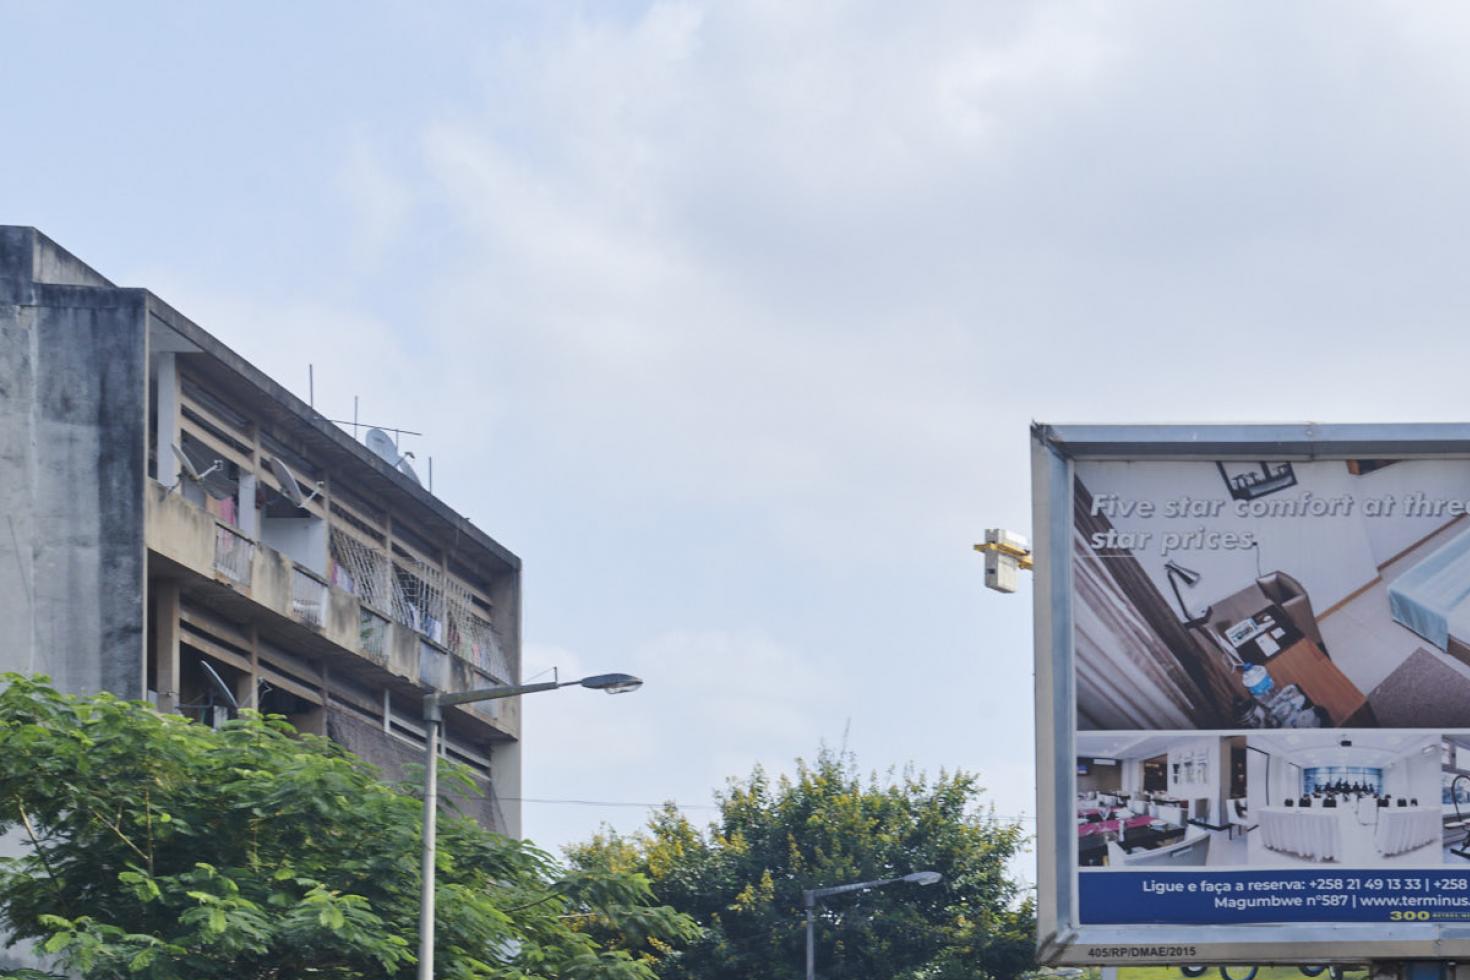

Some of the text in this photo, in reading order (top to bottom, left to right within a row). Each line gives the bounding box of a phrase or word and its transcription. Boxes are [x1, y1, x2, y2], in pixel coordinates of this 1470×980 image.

[1090, 493, 1155, 517] Five
[1163, 496, 1225, 517] star
[1233, 492, 1354, 517] comfort
[1362, 495, 1396, 517] at
[1090, 527, 1253, 556] star prices
[1142, 879, 1184, 895] Ligue
[1188, 882, 1198, 892] e
[1200, 880, 1232, 895] faça
[1235, 882, 1245, 892] a
[1248, 880, 1305, 892] reserva:
[1309, 878, 1343, 890] +258
[1347, 878, 1361, 890] 21
[1364, 878, 1384, 890] 49
[1387, 878, 1402, 890] 13
[1404, 878, 1422, 890] 33
[1433, 878, 1468, 890] +258
[1215, 895, 1303, 910] Magumbwe
[1390, 911, 1431, 920] 300
